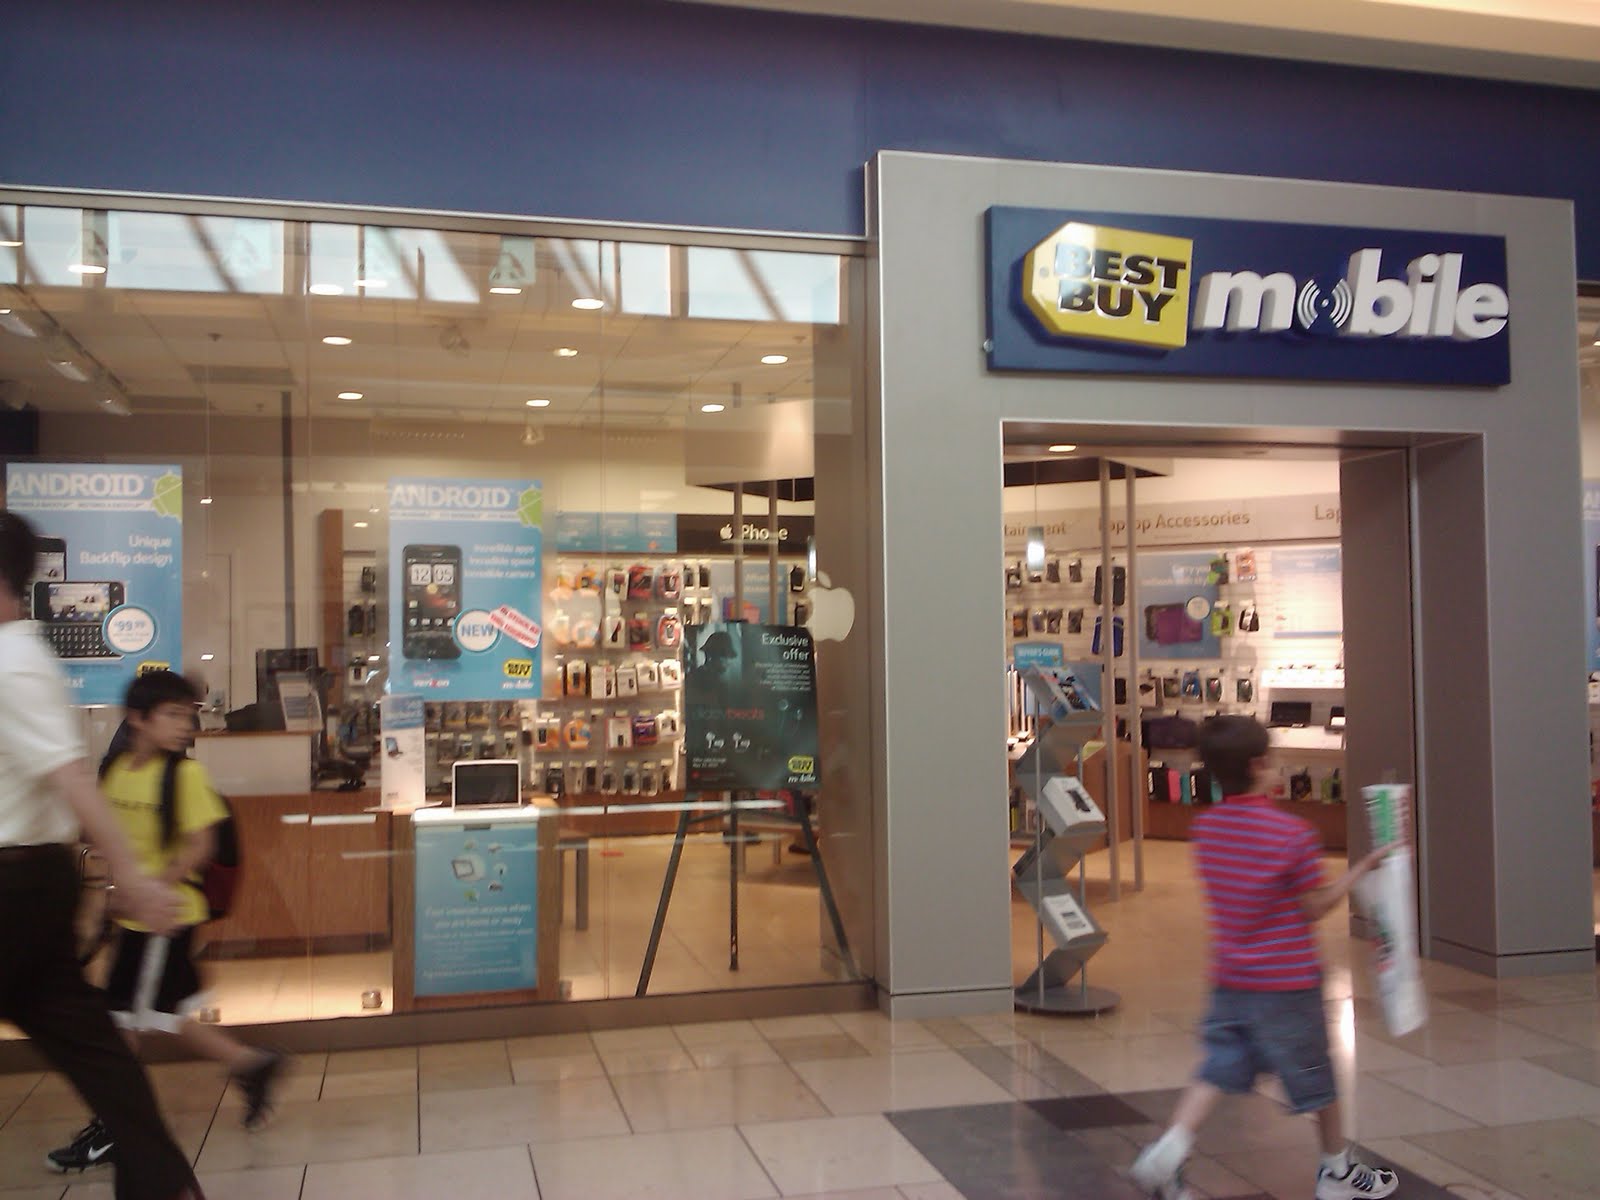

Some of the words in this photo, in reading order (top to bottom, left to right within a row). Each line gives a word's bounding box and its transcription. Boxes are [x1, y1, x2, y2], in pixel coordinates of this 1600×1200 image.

[1055, 242, 1187, 290] BEST
[1058, 279, 1174, 323] BUY
[1192, 248, 1509, 340] mobile
[9, 473, 144, 497] ANDROID
[389, 485, 510, 508] ANDROID
[1155, 511, 1250, 529] Accessories
[128, 534, 172, 550] Unique
[80, 551, 131, 568] Backflip
[132, 551, 173, 568] design
[460, 623, 494, 638] NEW
[761, 632, 809, 647] Exclusive
[783, 648, 809, 660] offer
[413, 679, 449, 688] verizon
